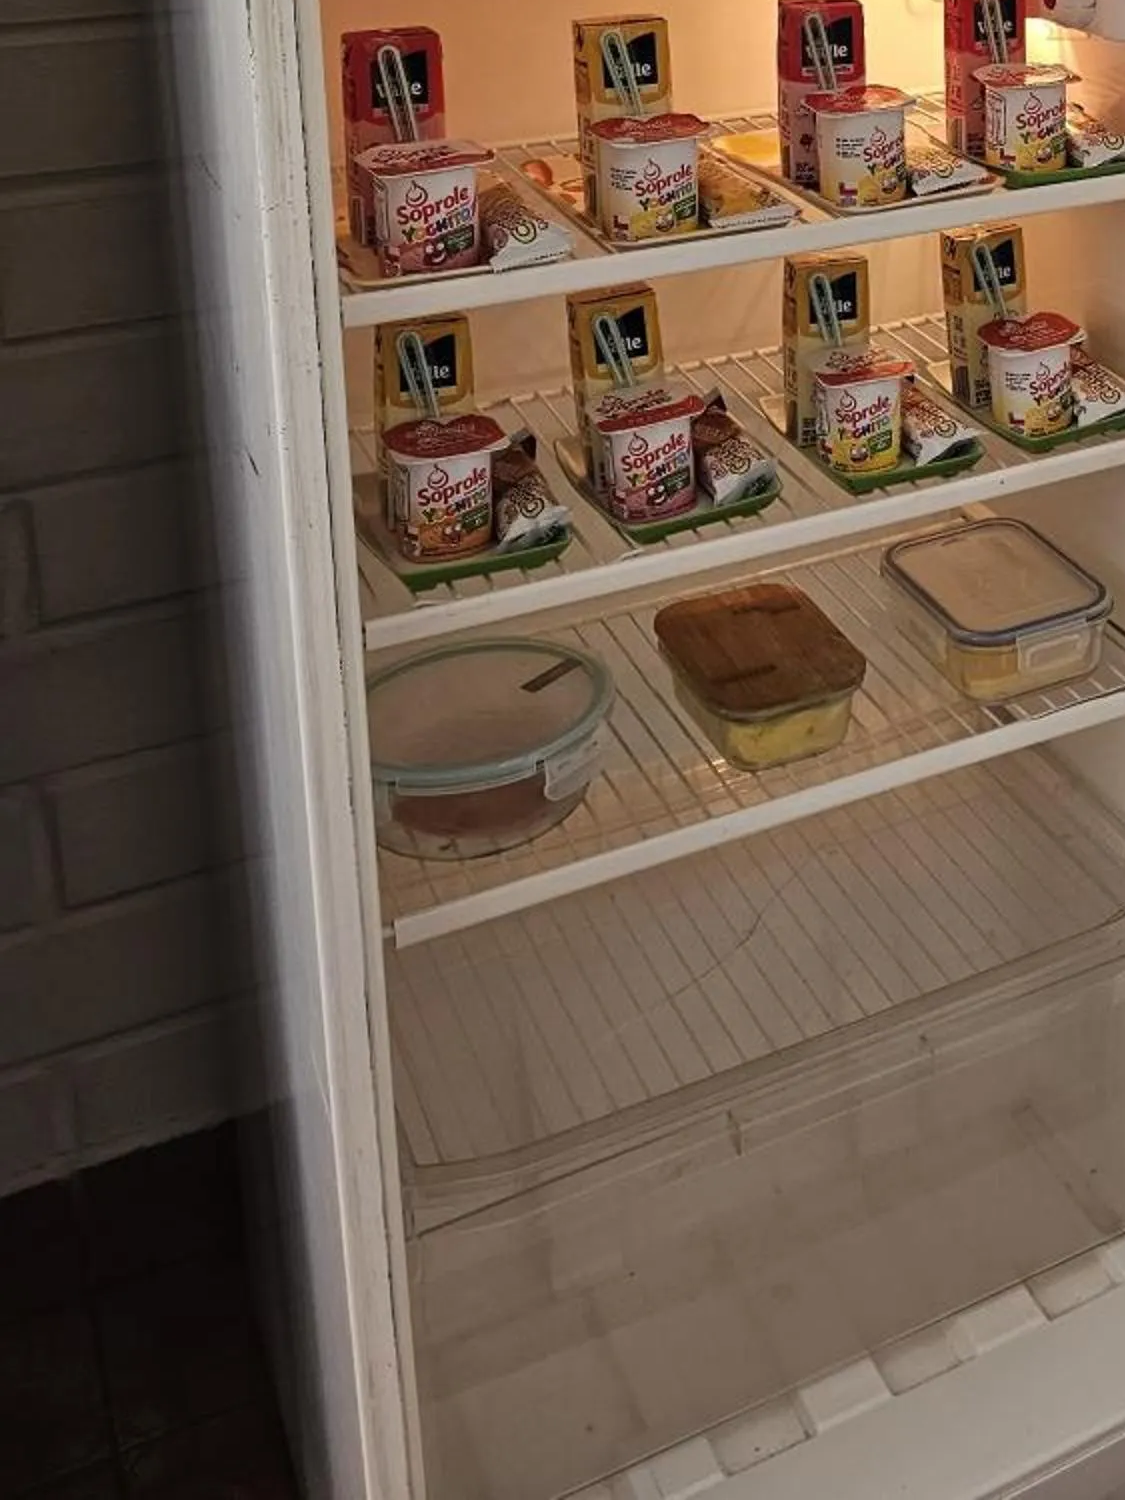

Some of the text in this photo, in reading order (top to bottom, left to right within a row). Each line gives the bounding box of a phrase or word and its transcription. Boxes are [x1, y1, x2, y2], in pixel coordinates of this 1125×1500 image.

[635, 164, 693, 197] Soprole
[397, 185, 469, 226] Soprole
[835, 395, 891, 427] Soprole
[621, 433, 685, 473] Soprole
[417, 467, 488, 507] Soprole
